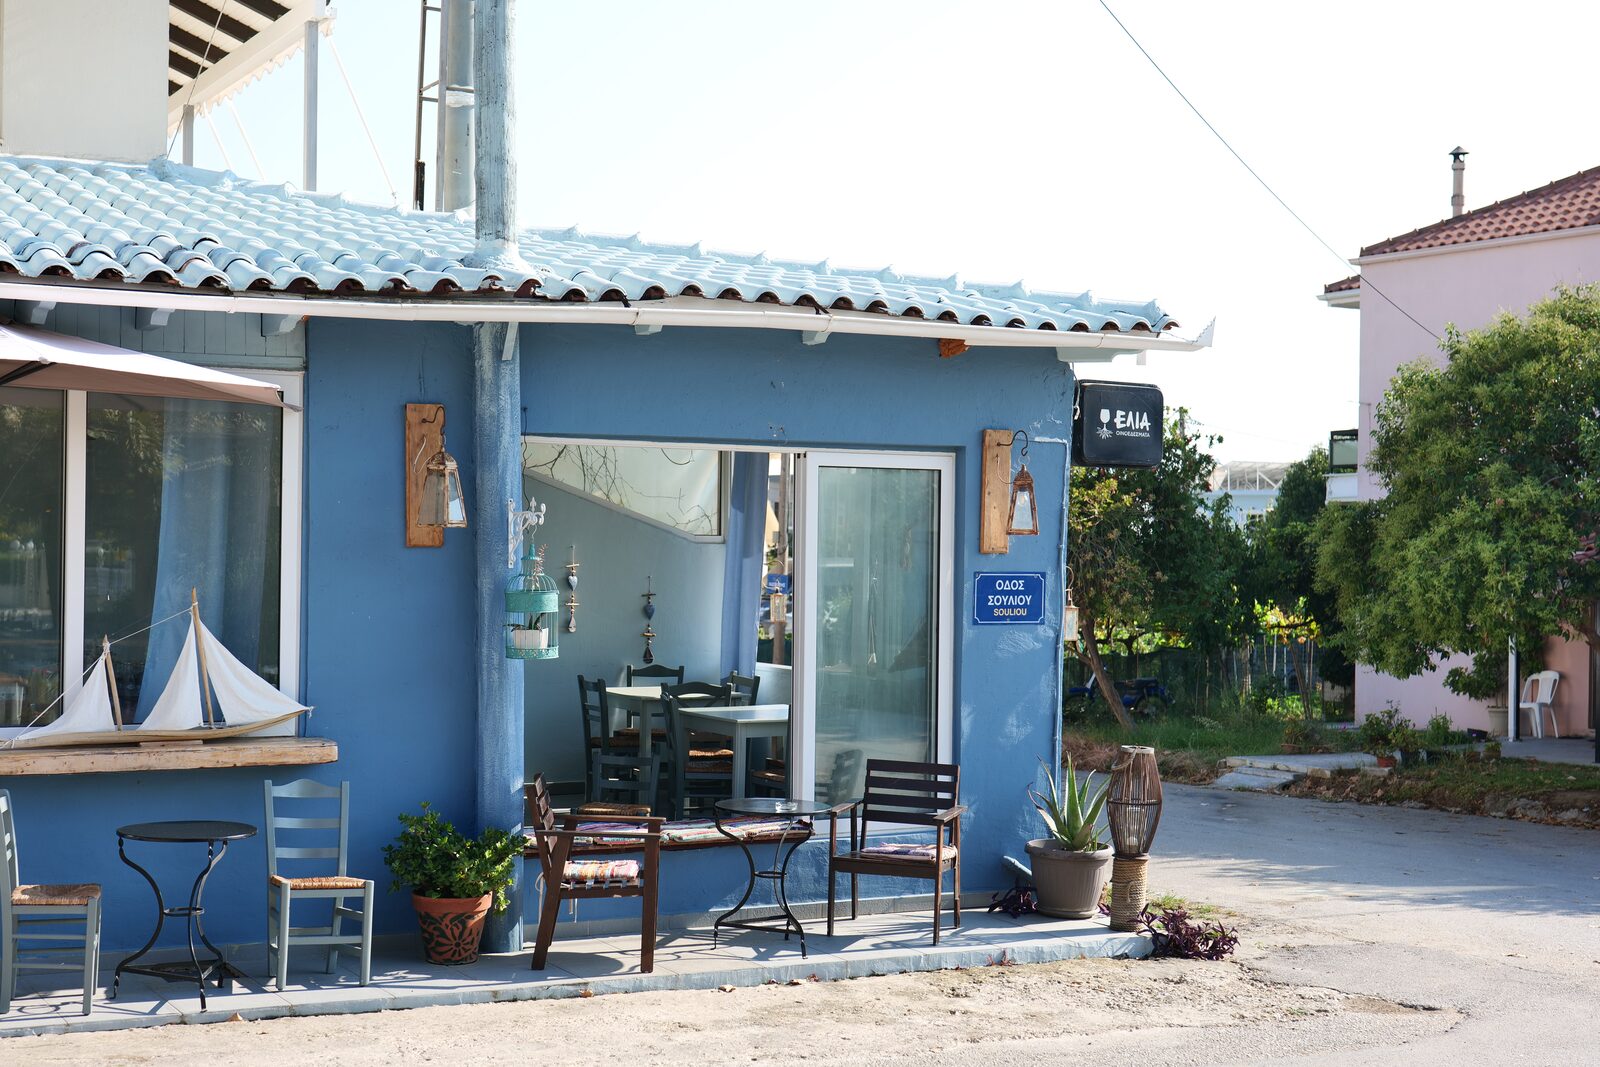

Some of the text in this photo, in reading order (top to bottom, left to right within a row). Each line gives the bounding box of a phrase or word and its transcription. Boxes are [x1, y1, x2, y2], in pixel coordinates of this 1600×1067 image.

[1114, 410, 1151, 431] ΕΛΙΑ
[995, 580, 1025, 590] ΟΔΟΣ
[987, 595, 1032, 606] ΣΟΥΛΙΟΥ
[993, 608, 1027, 616] SOULIOU
